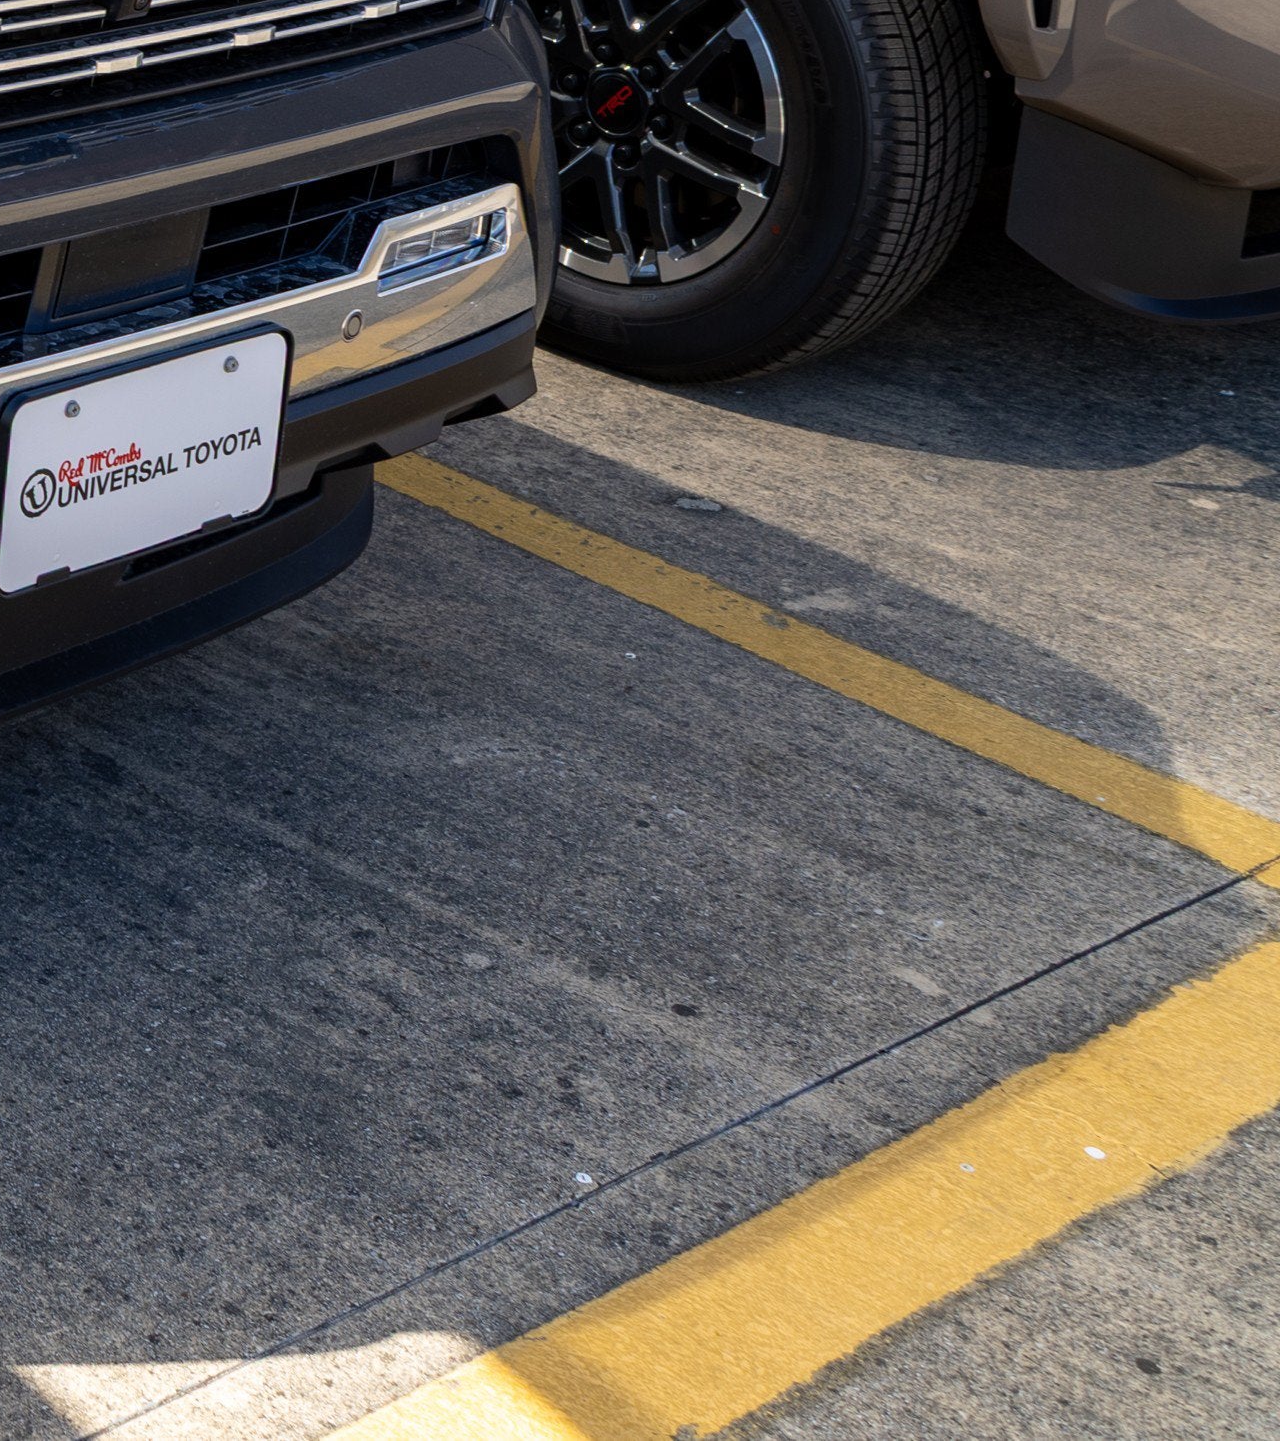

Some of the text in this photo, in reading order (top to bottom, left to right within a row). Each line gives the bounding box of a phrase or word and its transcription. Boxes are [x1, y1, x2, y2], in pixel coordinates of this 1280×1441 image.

[597, 85, 633, 117] TRD
[58, 443, 142, 487] Red McCombs
[58, 426, 262, 508] UNIVERSAL TOYOTA
